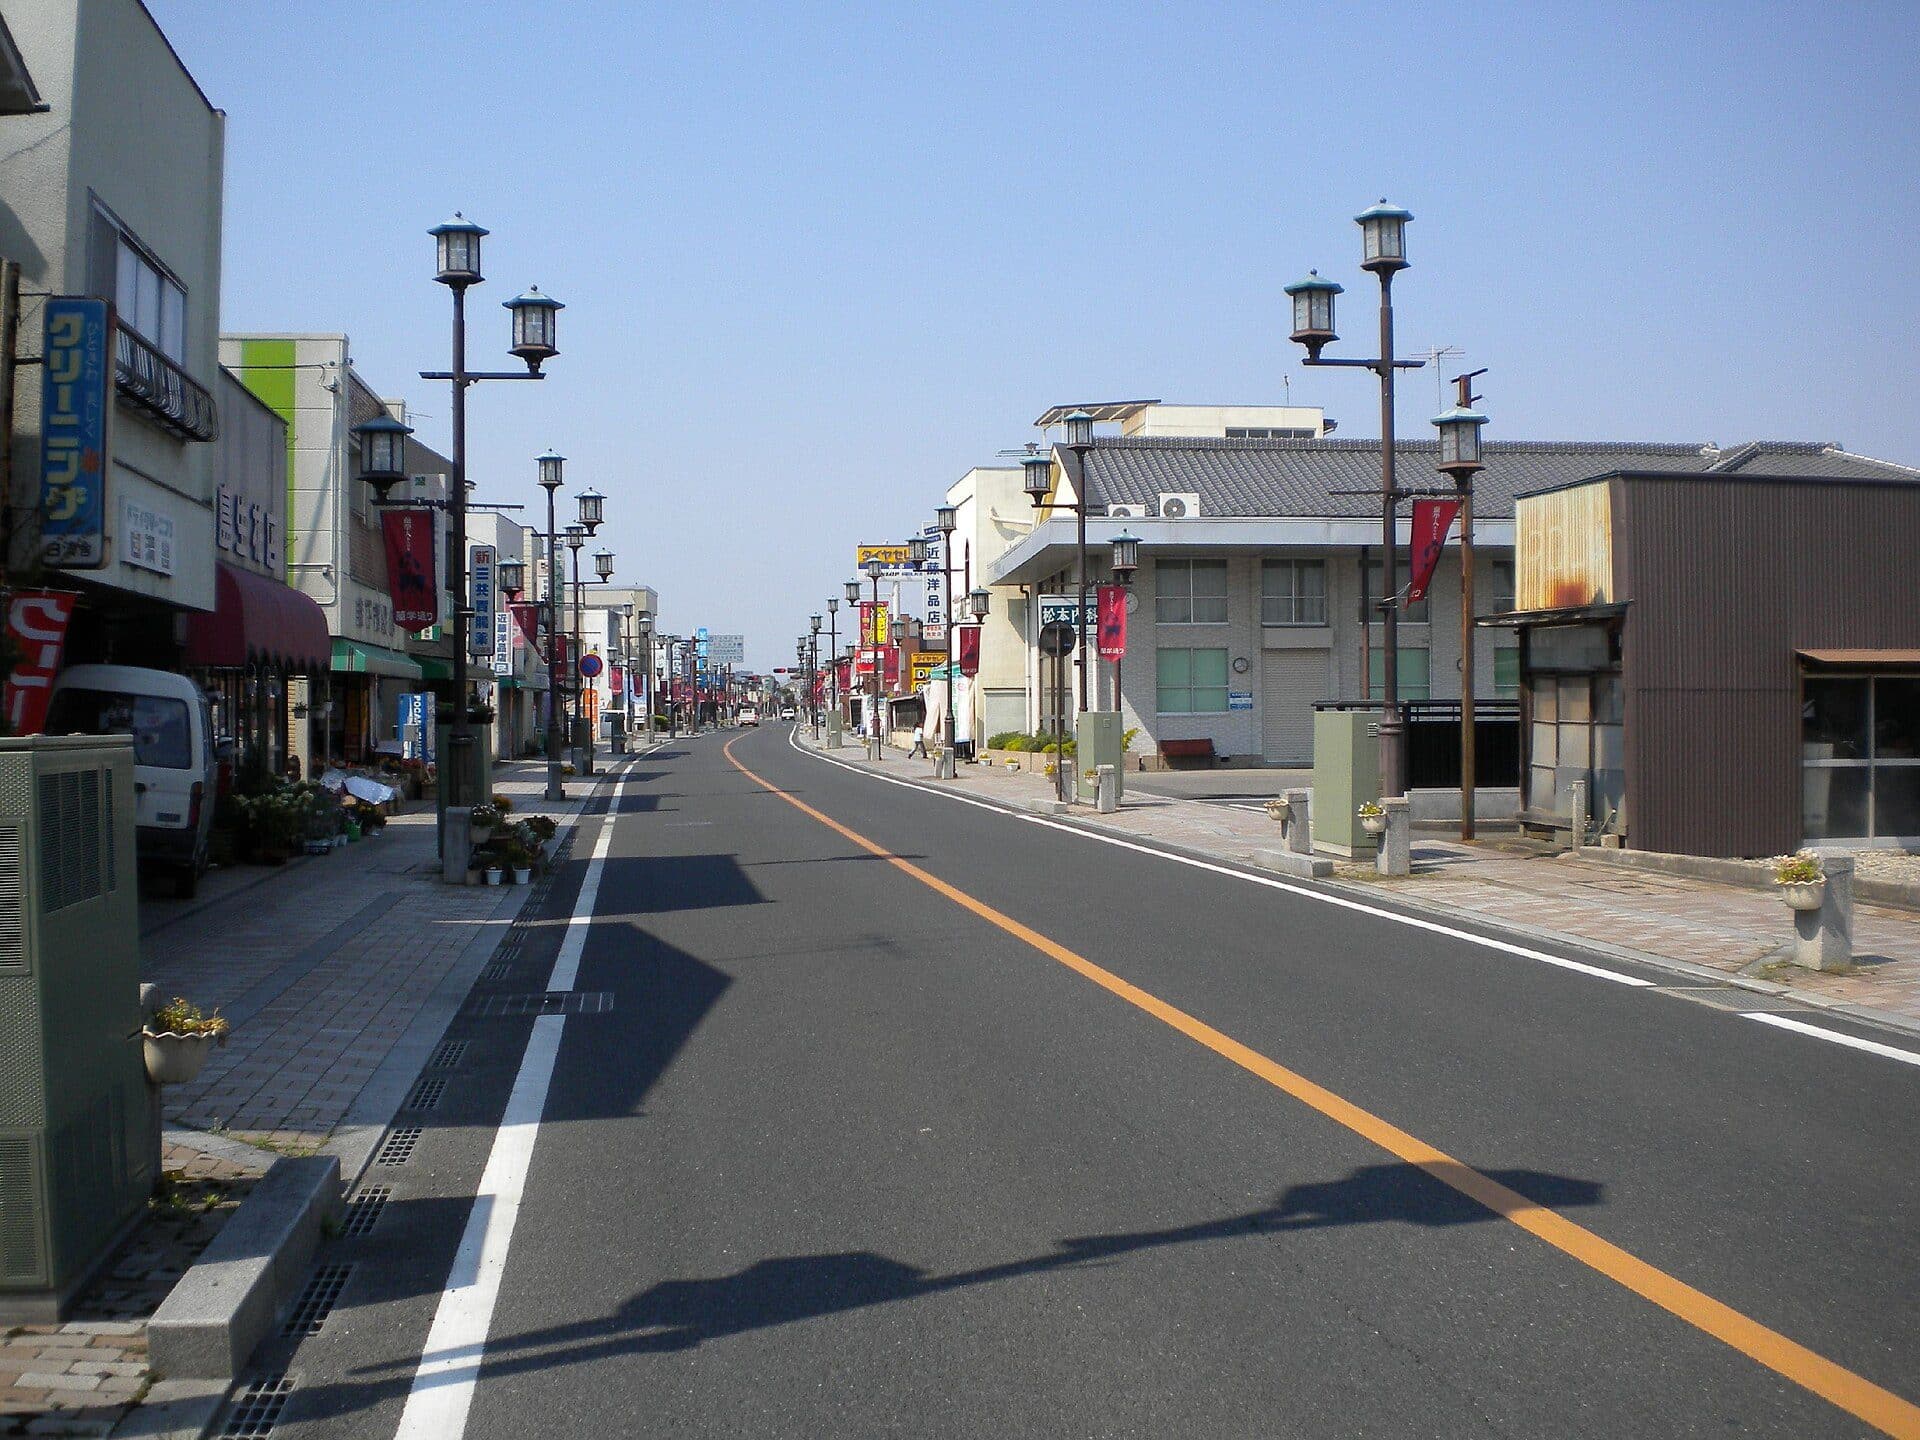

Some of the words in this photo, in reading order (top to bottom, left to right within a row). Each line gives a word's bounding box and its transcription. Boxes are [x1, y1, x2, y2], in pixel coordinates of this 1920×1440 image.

[49, 312, 85, 519] クリーニング
[926, 546, 940, 624] 近藤洋品店
[1042, 607, 1098, 624] 松本内科
